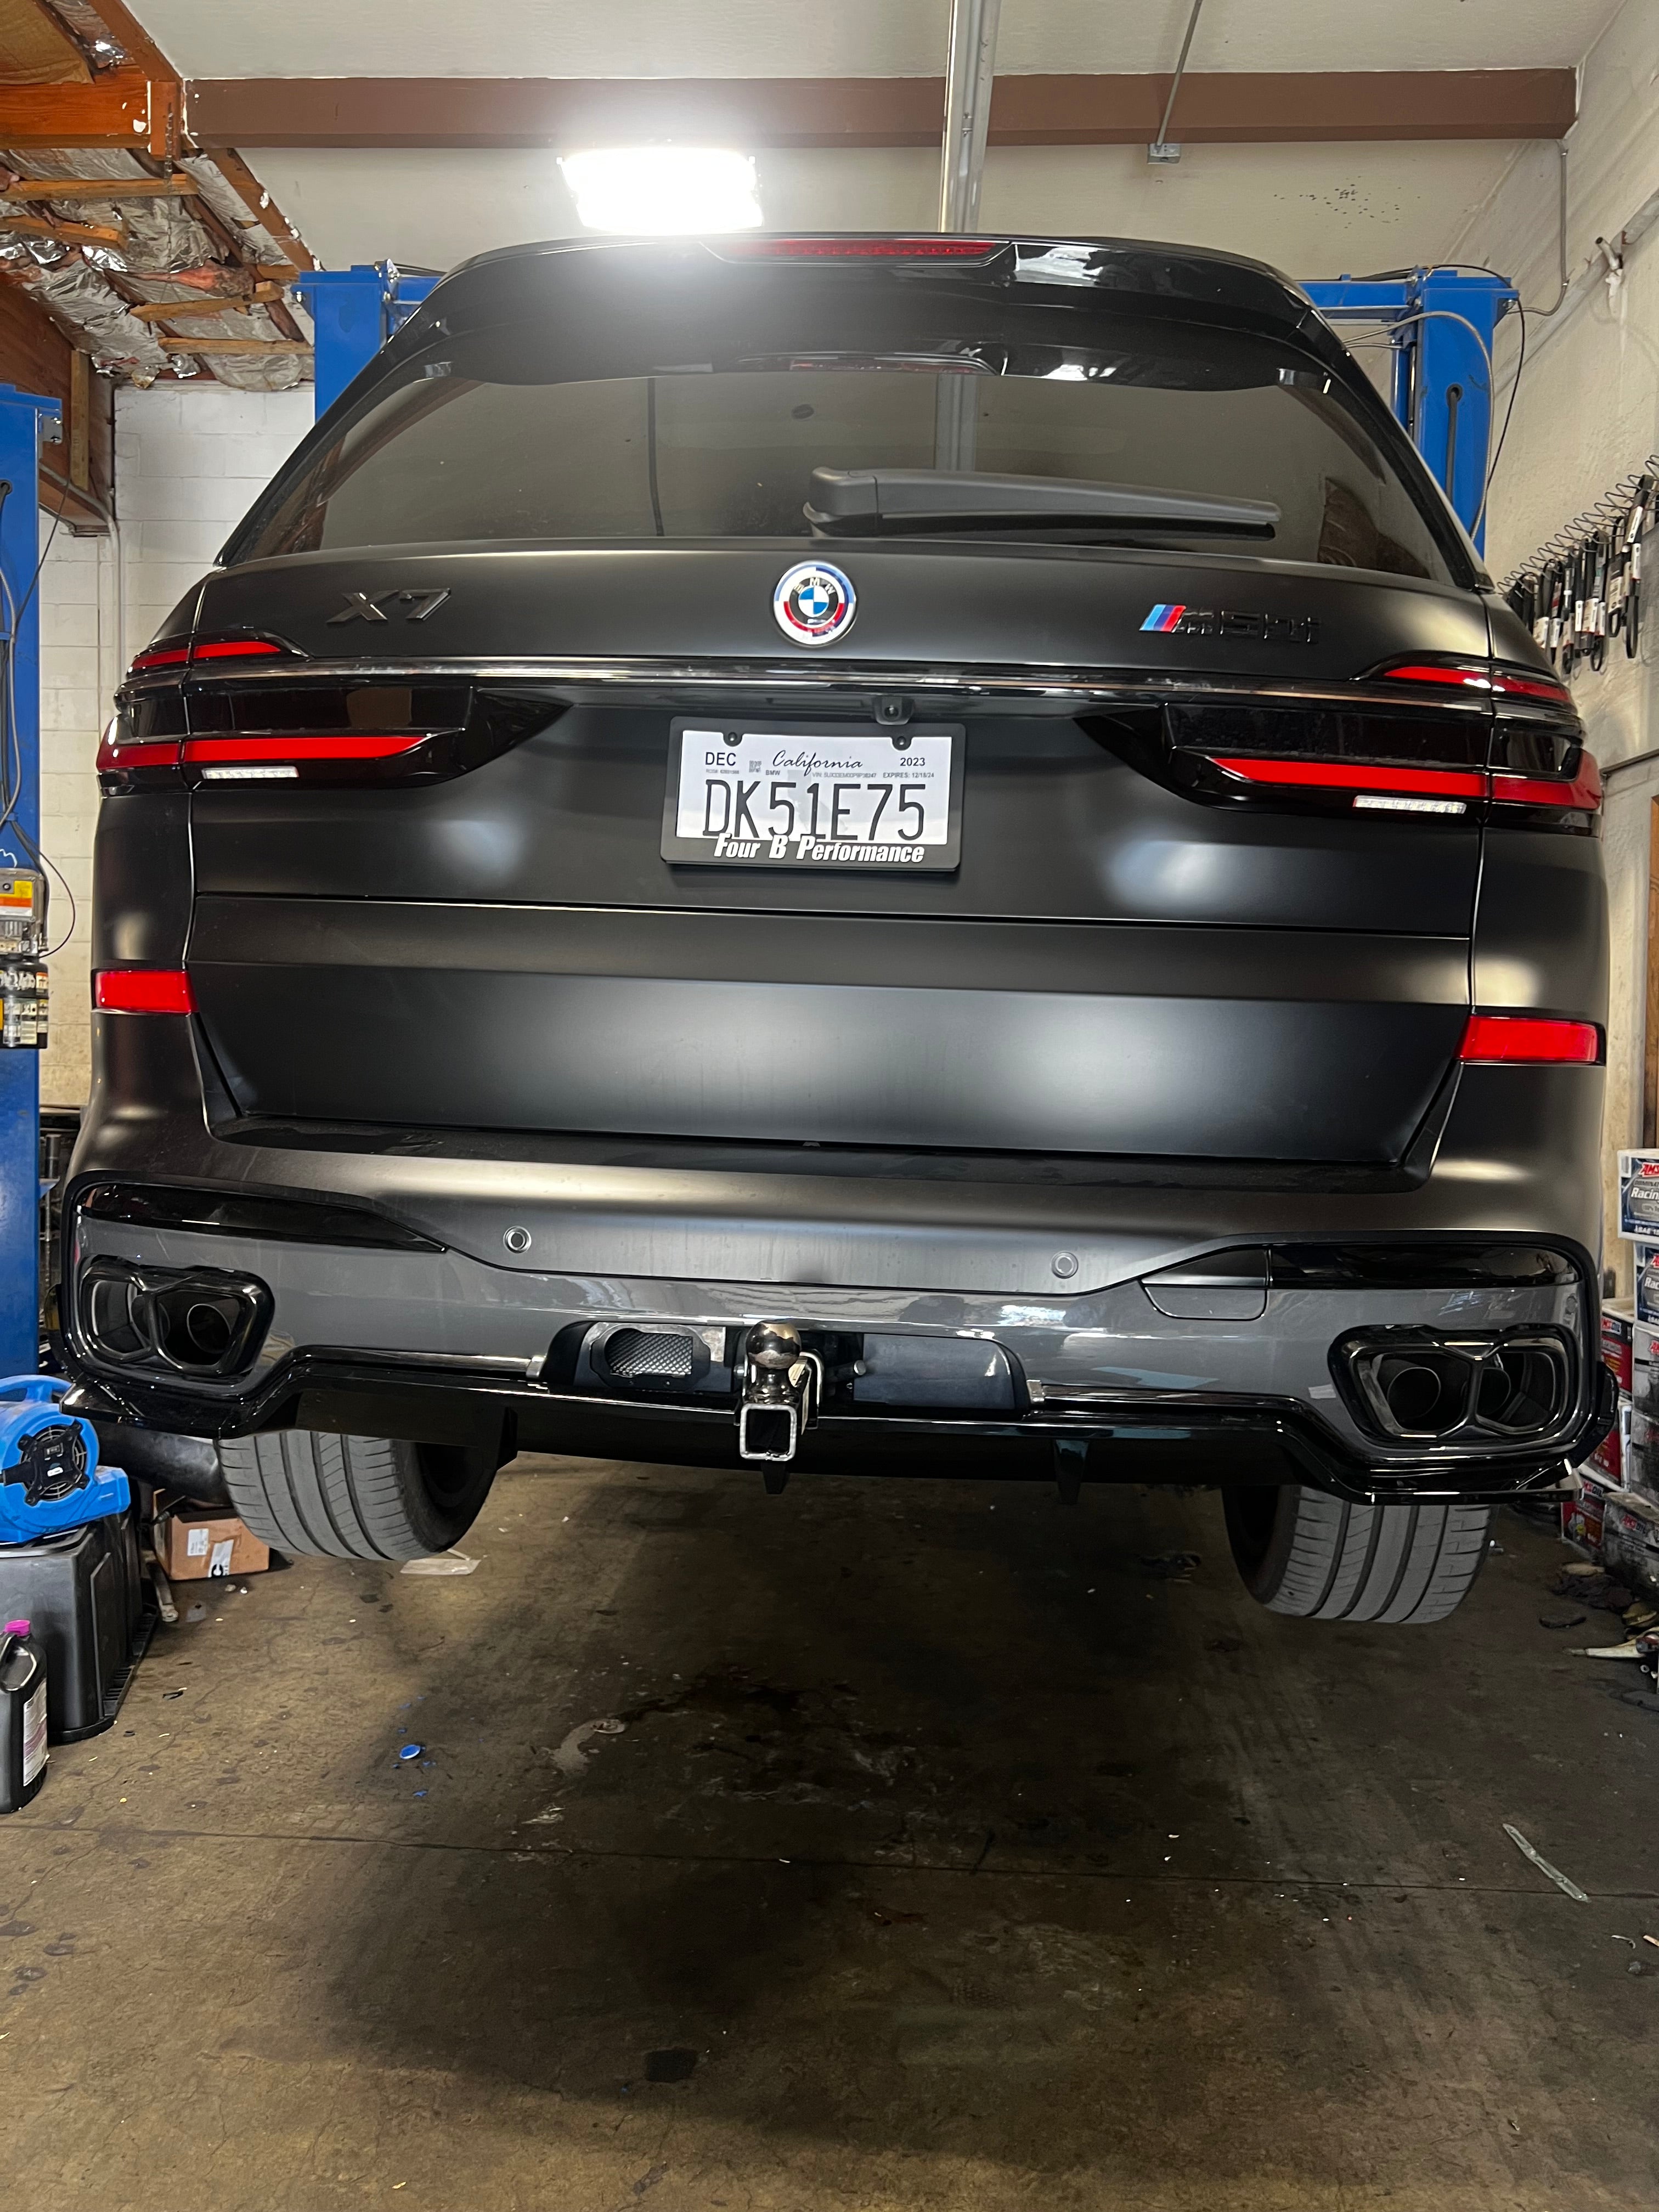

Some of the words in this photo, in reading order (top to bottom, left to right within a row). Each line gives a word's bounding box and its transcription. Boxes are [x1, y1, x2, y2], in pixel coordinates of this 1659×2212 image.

[793, 577, 836, 595] BMW
[326, 588, 452, 623] X7
[705, 752, 737, 767] DEC
[772, 749, 863, 777] California
[899, 757, 926, 767] 2023
[702, 778, 927, 841] DK51E75
[714, 832, 761, 859] Four
[769, 834, 789, 860] B
[795, 834, 925, 863] Performance
[1631, 1187, 1659, 1203] Racin
